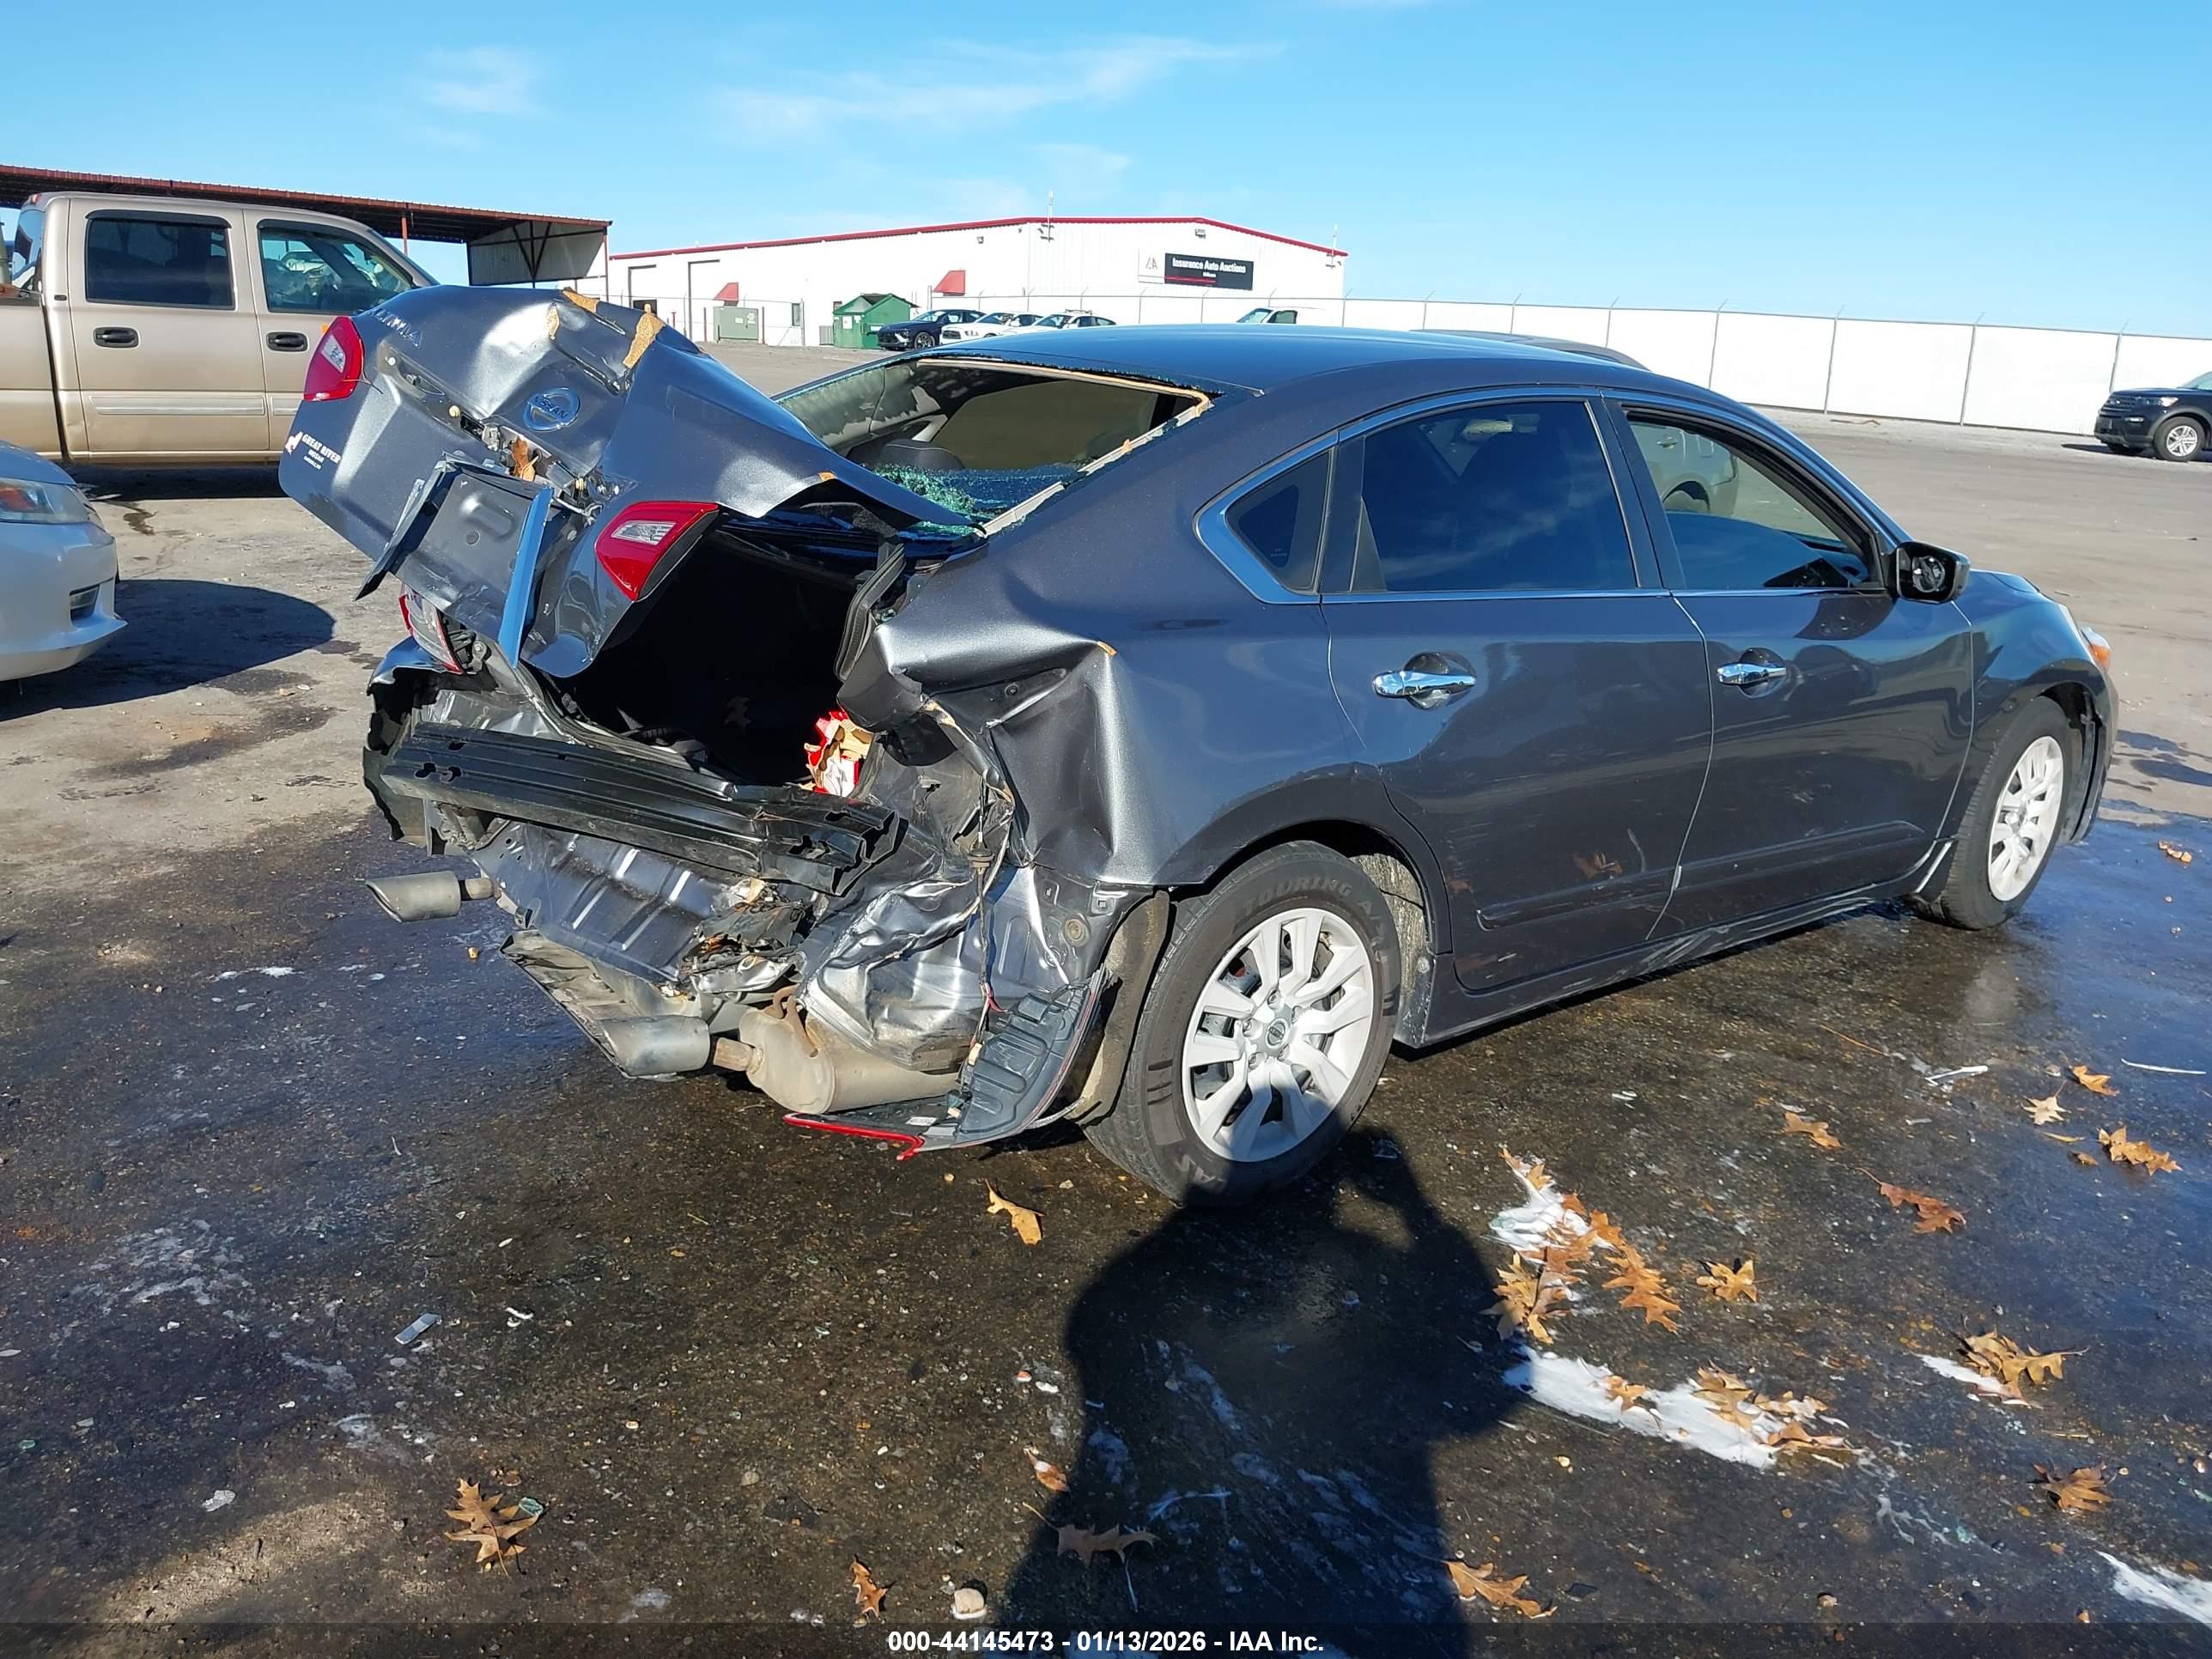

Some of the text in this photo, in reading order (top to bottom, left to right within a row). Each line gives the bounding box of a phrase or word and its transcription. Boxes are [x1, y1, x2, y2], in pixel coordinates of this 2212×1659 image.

[1172, 258, 1203, 270] Insurance
[1204, 259, 1219, 271] Auto
[1220, 261, 1247, 274] Auctions
[301, 434, 323, 452] GREAT
[319, 445, 341, 464] RIVER
